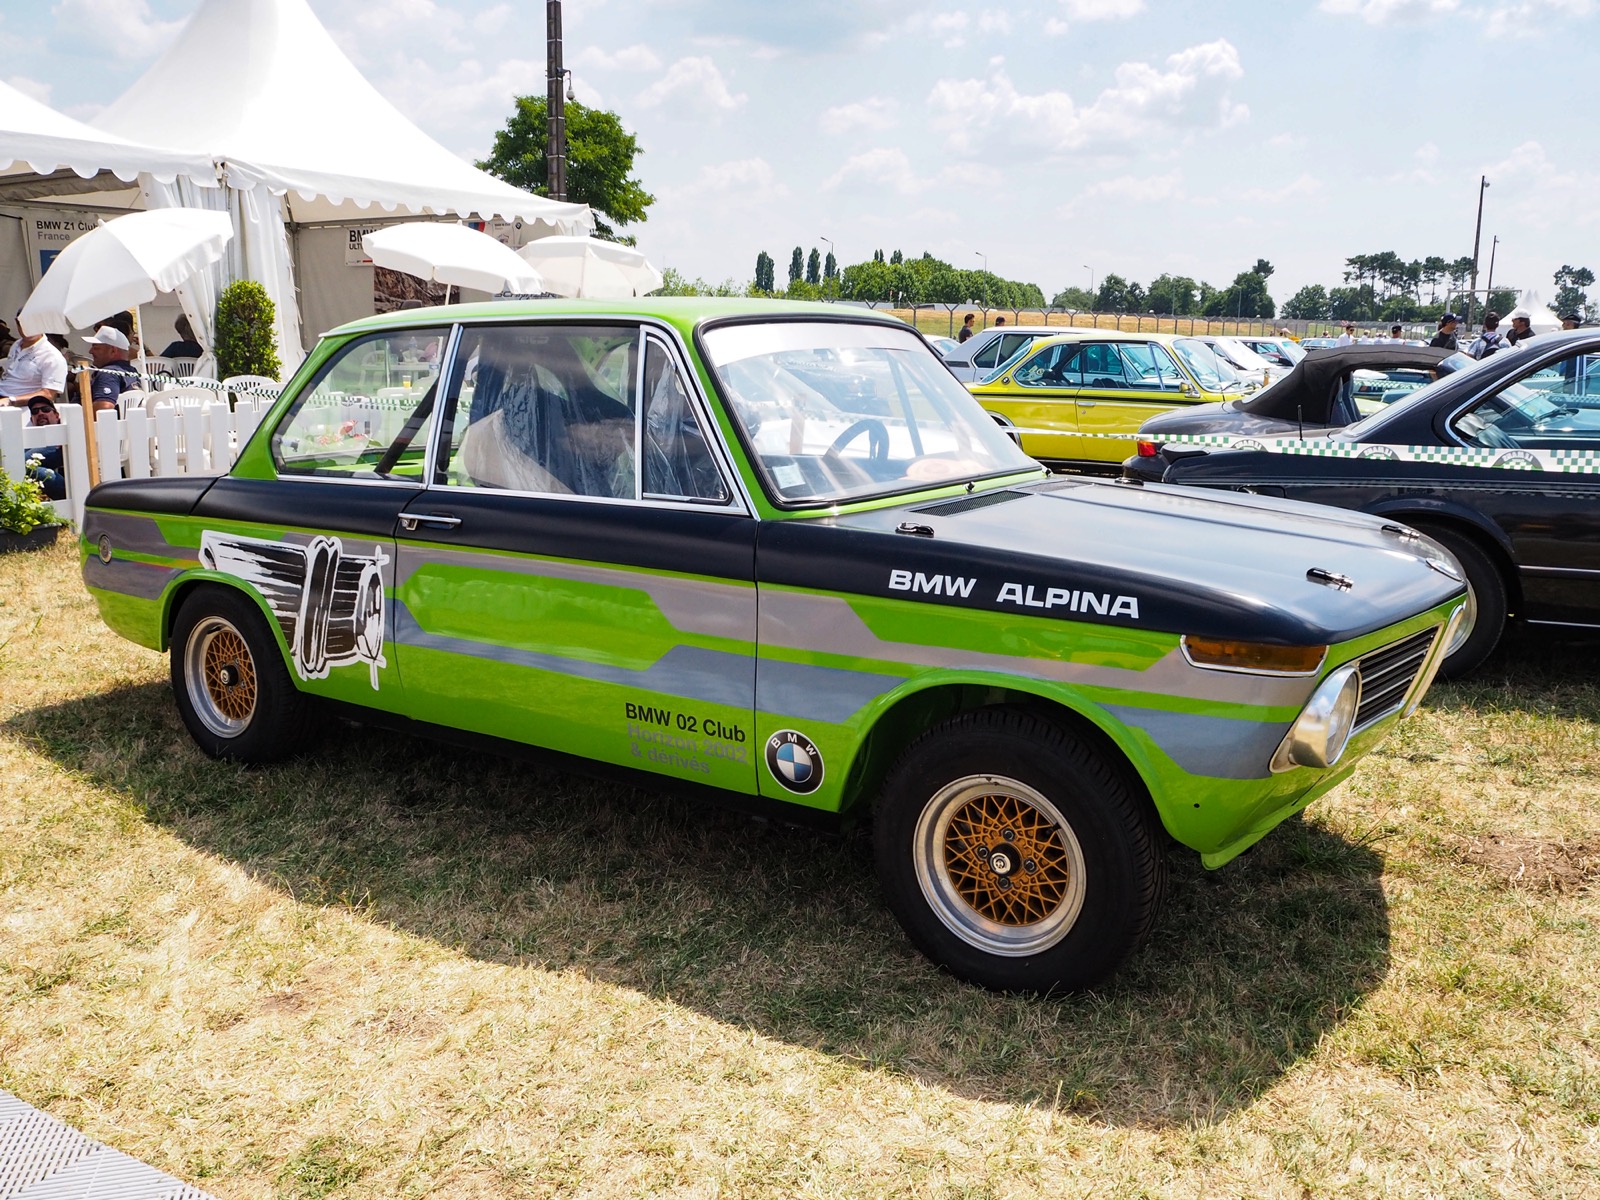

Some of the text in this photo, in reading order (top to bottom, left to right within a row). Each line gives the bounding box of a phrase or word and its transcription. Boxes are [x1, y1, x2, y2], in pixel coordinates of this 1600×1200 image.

[36, 220, 61, 230] BMW
[64, 221, 75, 231] Z1
[37, 231, 71, 241] France
[888, 569, 1139, 619] BMW ALPINA
[625, 702, 746, 743] BMW 02 Club
[626, 722, 748, 764] Horizon 2002
[631, 742, 710, 774] & dérivés
[771, 733, 817, 756] BMW
